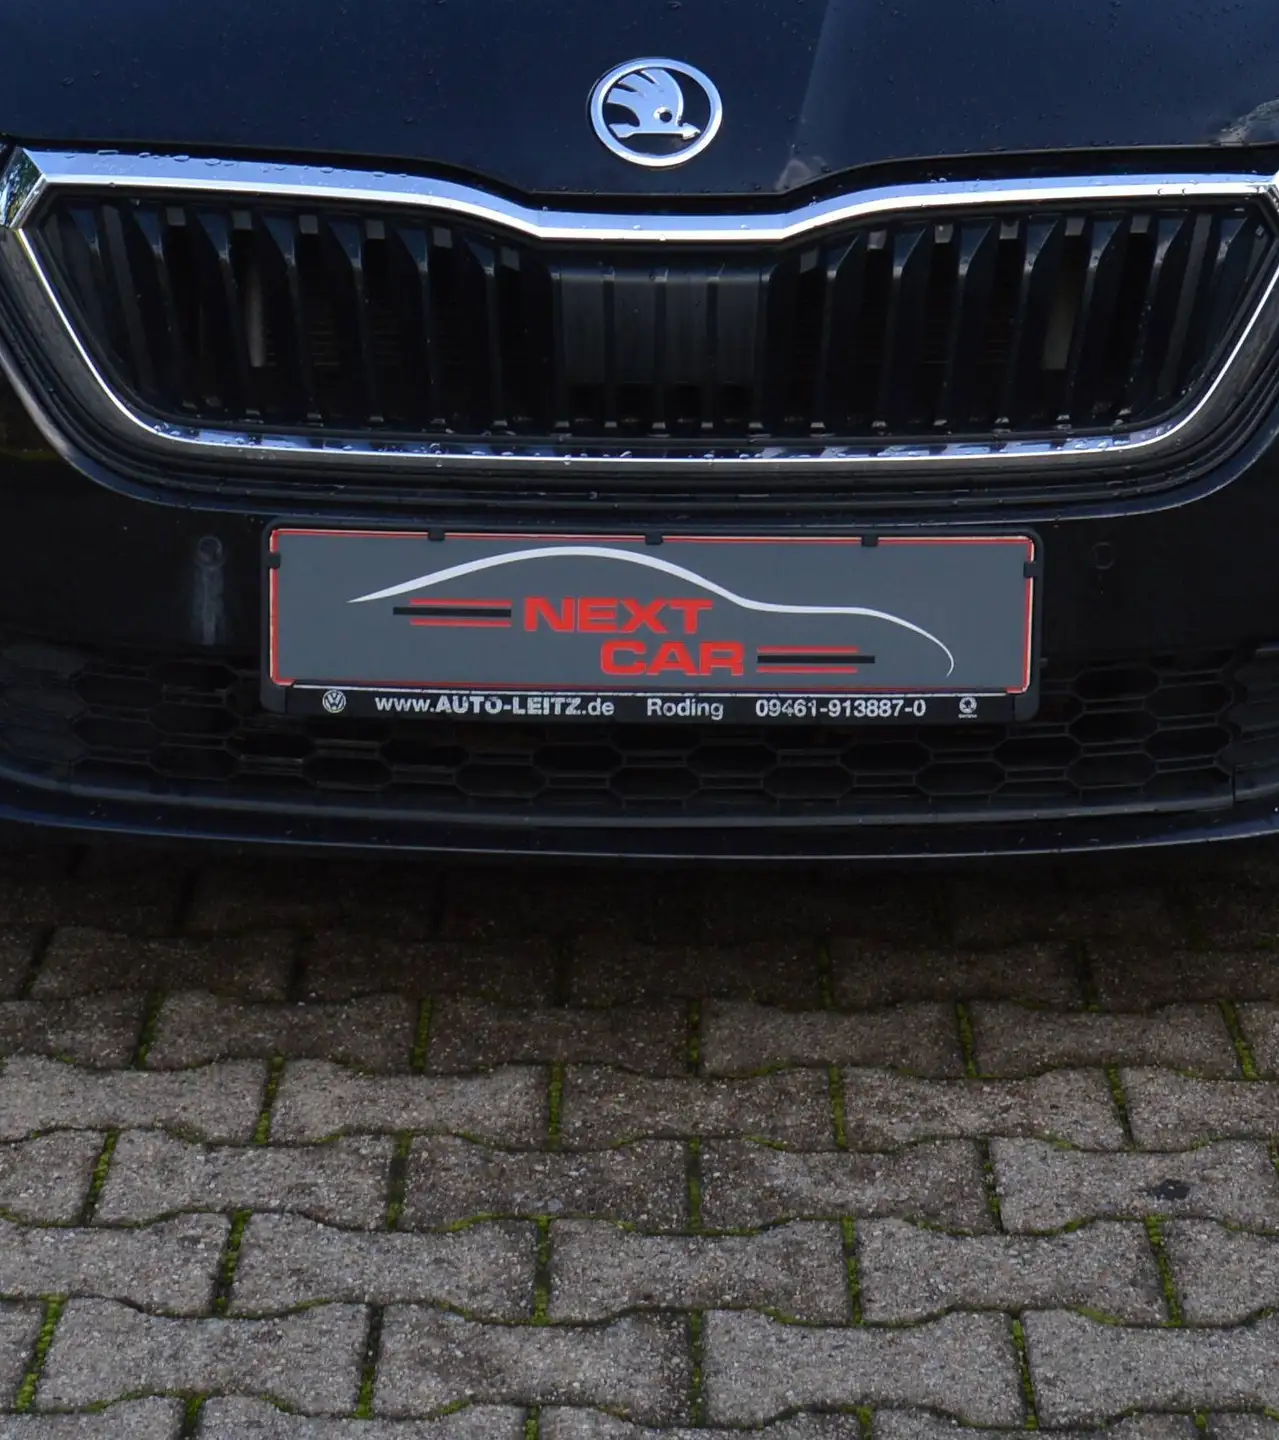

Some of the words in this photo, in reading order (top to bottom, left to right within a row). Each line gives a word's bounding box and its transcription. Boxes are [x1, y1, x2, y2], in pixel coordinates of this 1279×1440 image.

[523, 596, 714, 635] NEXT
[600, 640, 744, 676] CAR
[374, 694, 616, 716] www.AUTO-LEITZ.de
[646, 697, 724, 720] Roding
[755, 699, 927, 718] 09461-913887-0
